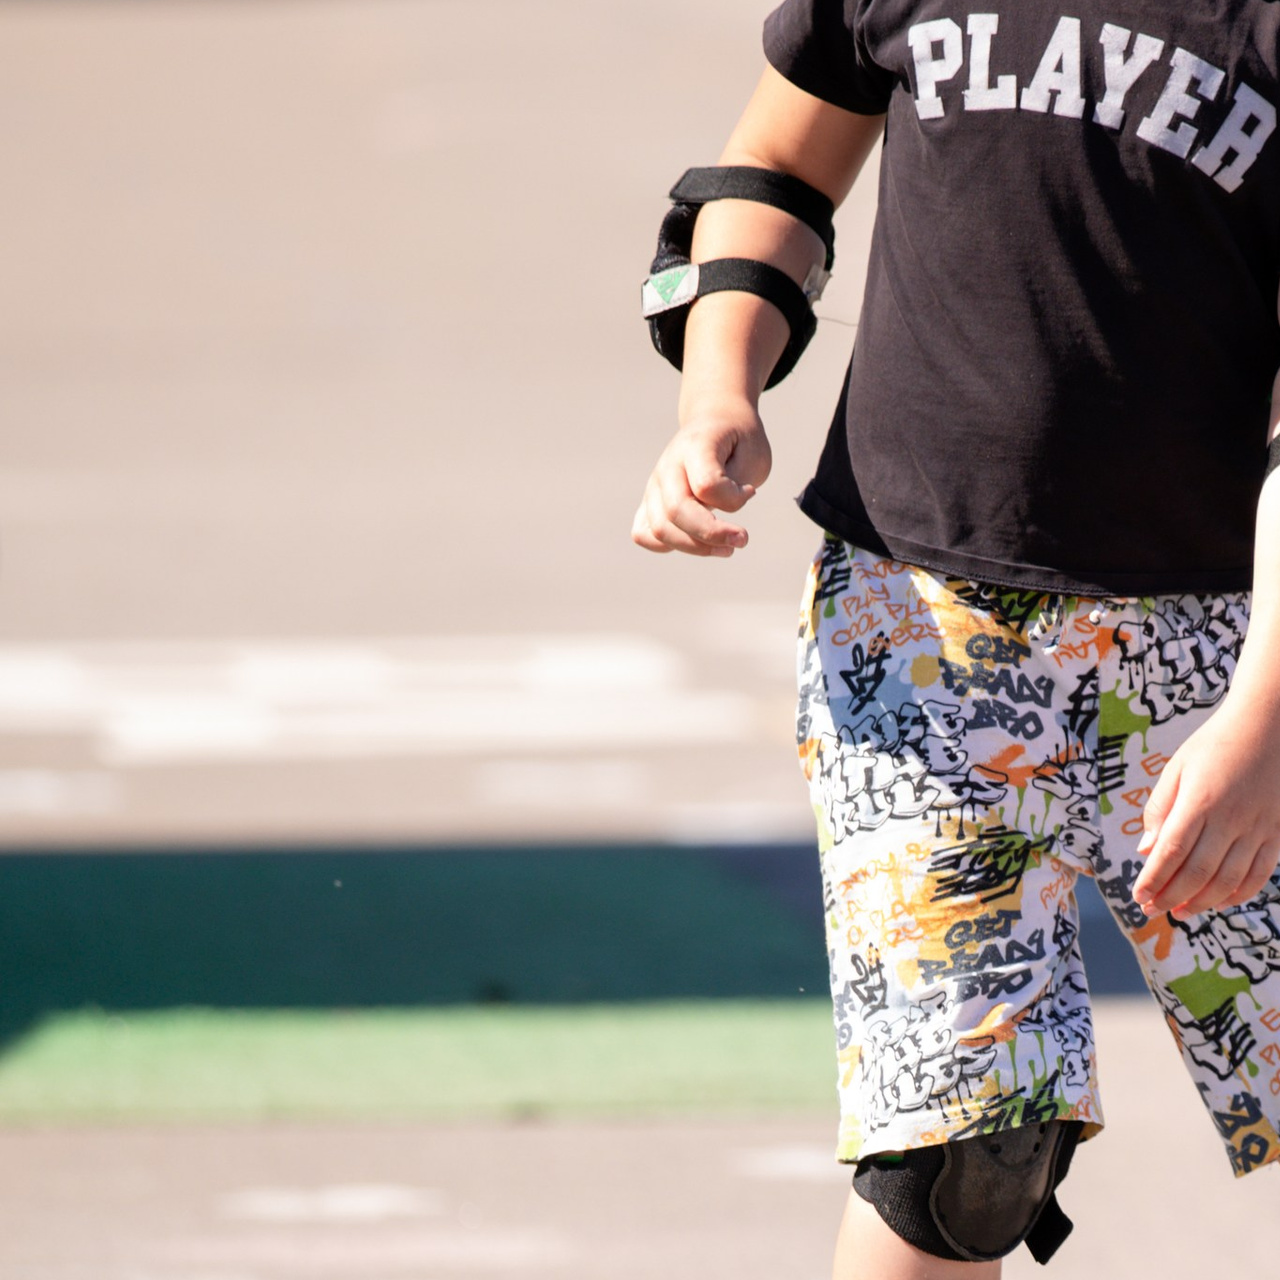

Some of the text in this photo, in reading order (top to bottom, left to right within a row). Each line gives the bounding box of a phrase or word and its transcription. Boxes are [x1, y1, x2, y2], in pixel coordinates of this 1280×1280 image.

[908, 13, 1278, 194] PLAYER
[965, 632, 1032, 669] GET
[938, 657, 1055, 709] READY
[965, 698, 1044, 741] BRO
[944, 909, 1023, 950] GET
[917, 927, 1047, 986] READY
